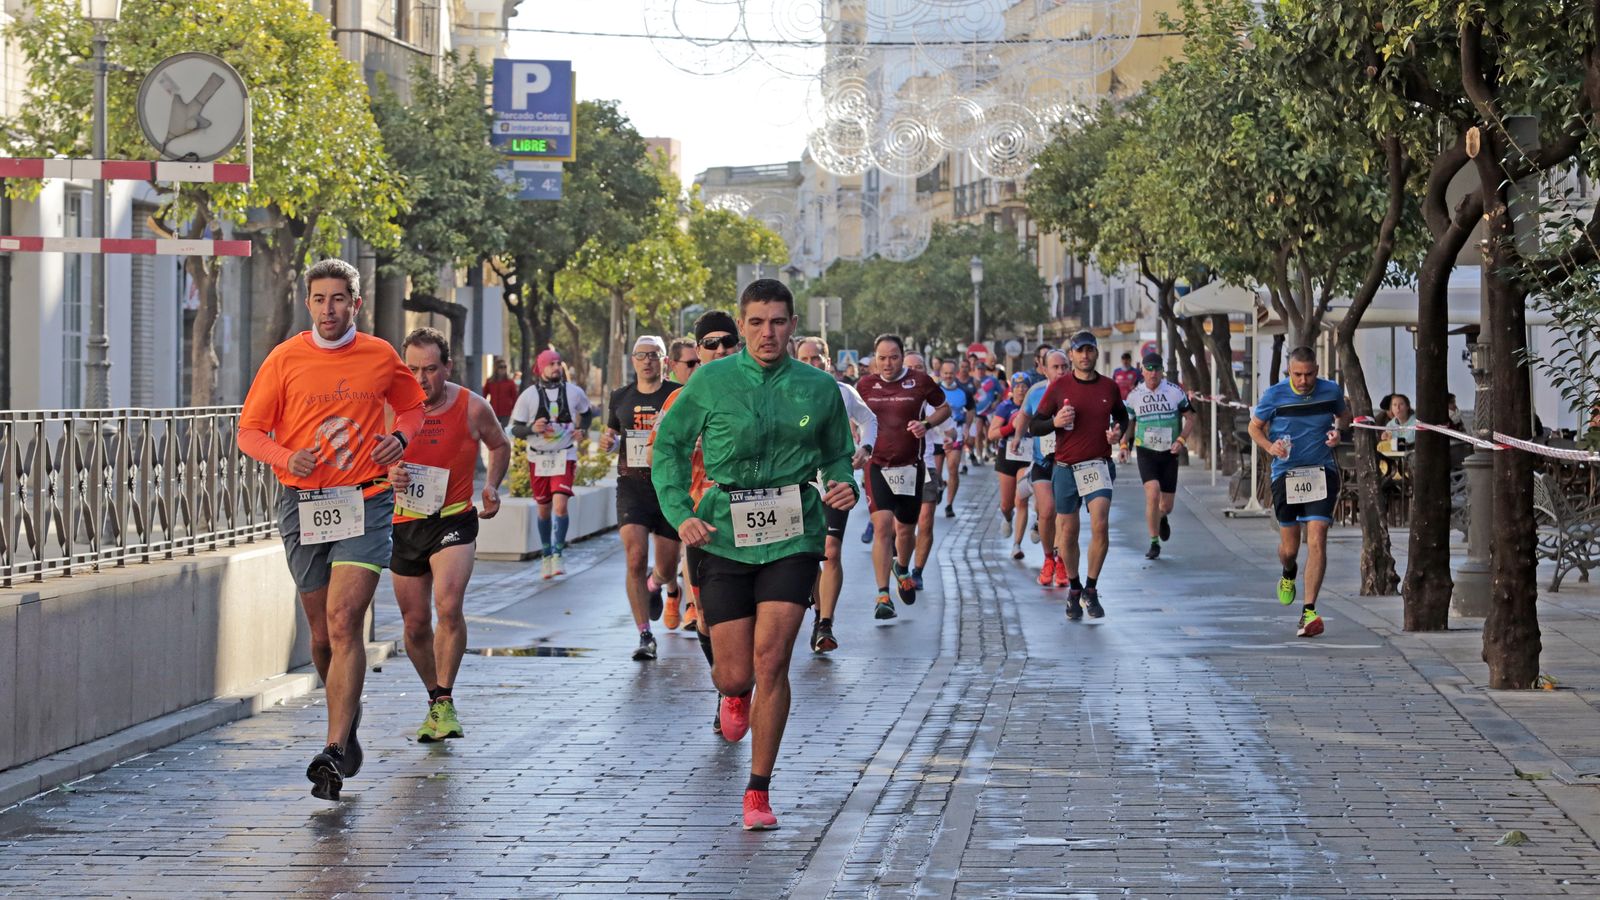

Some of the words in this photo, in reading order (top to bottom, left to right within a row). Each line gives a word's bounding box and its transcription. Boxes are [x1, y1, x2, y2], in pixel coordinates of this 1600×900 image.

[511, 62, 552, 110] P
[512, 138, 547, 152] LIBRE
[1142, 393, 1168, 404] CAJA
[1140, 403, 1174, 415] RURAL
[888, 474, 905, 485] 605
[1082, 471, 1099, 485] 550
[1294, 481, 1312, 493] 440
[299, 492, 311, 501] XXV
[730, 492, 744, 502] XXV
[754, 500, 777, 508] PABLO
[313, 508, 342, 527] 693
[746, 509, 777, 529] 534
